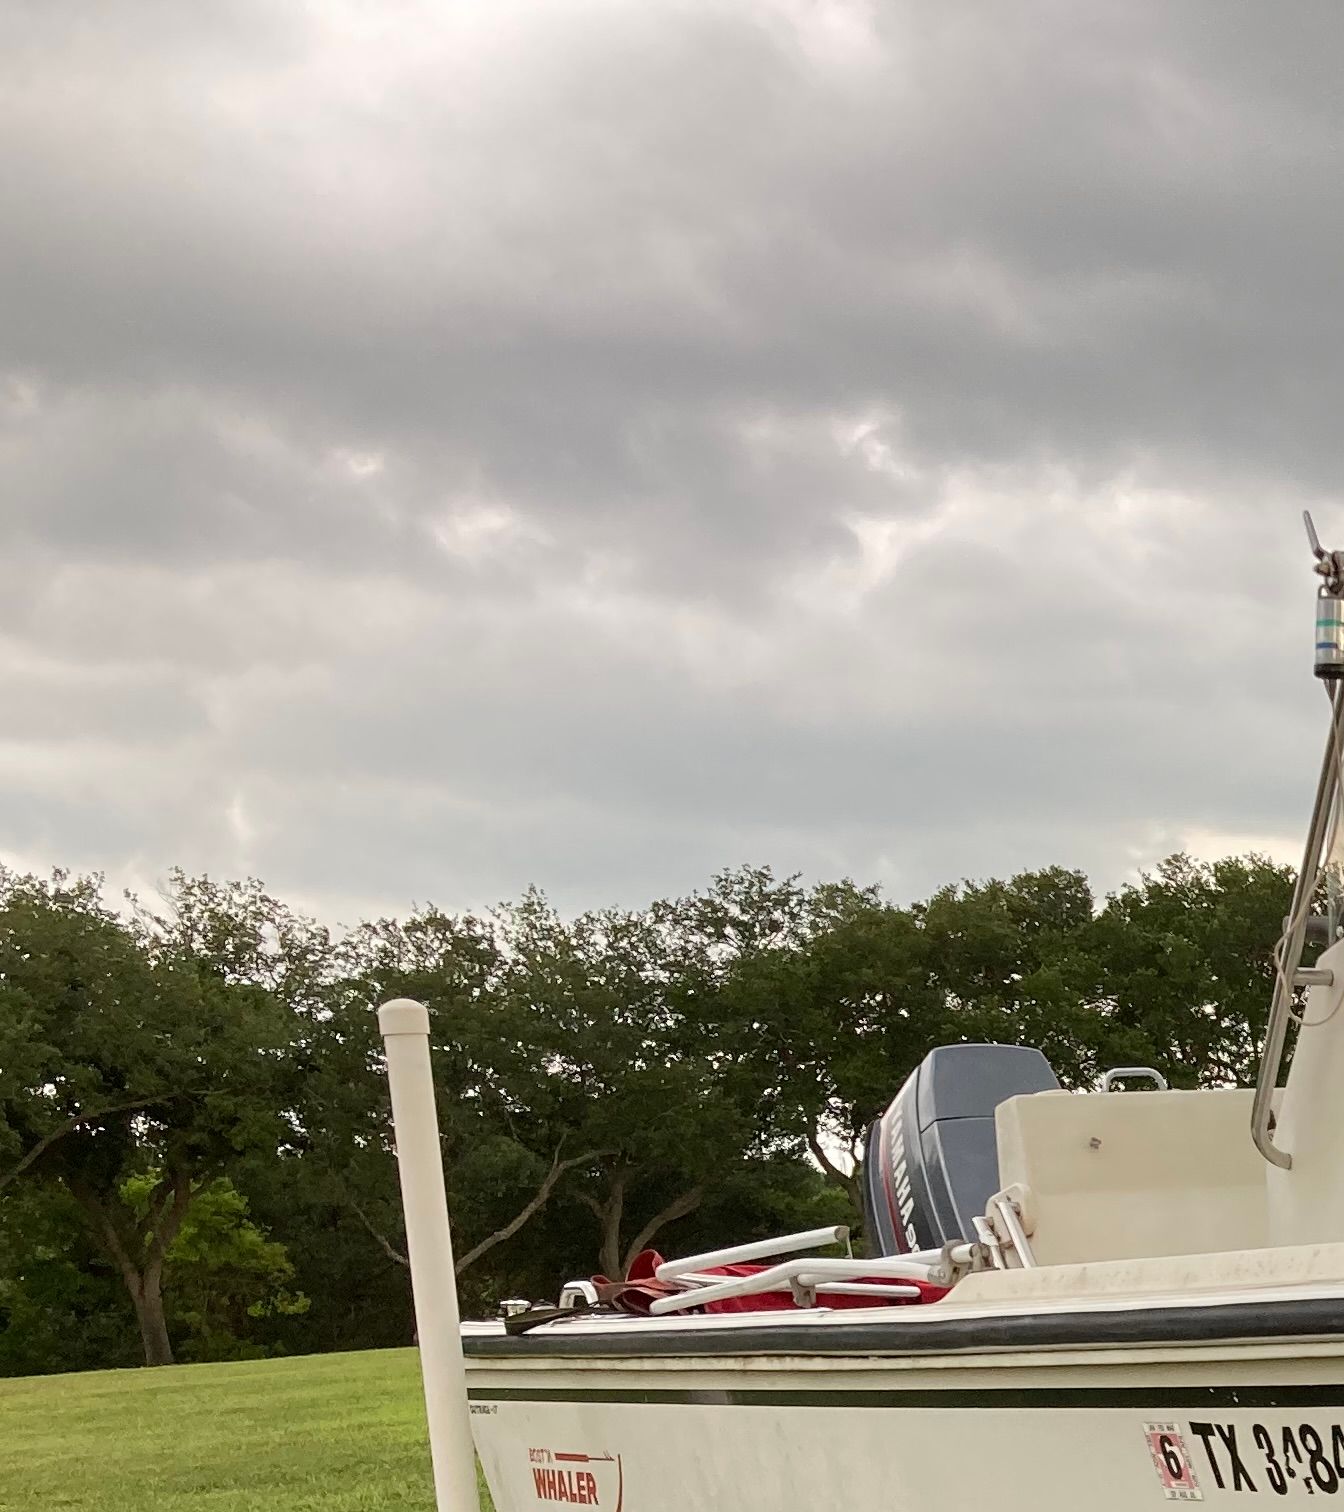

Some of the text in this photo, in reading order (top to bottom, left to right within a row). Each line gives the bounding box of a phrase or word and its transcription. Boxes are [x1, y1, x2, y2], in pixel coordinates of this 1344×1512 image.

[1159, 1435, 1183, 1480] 6
[1189, 1421, 1258, 1492] TX
[532, 1467, 599, 1505] WHALER
